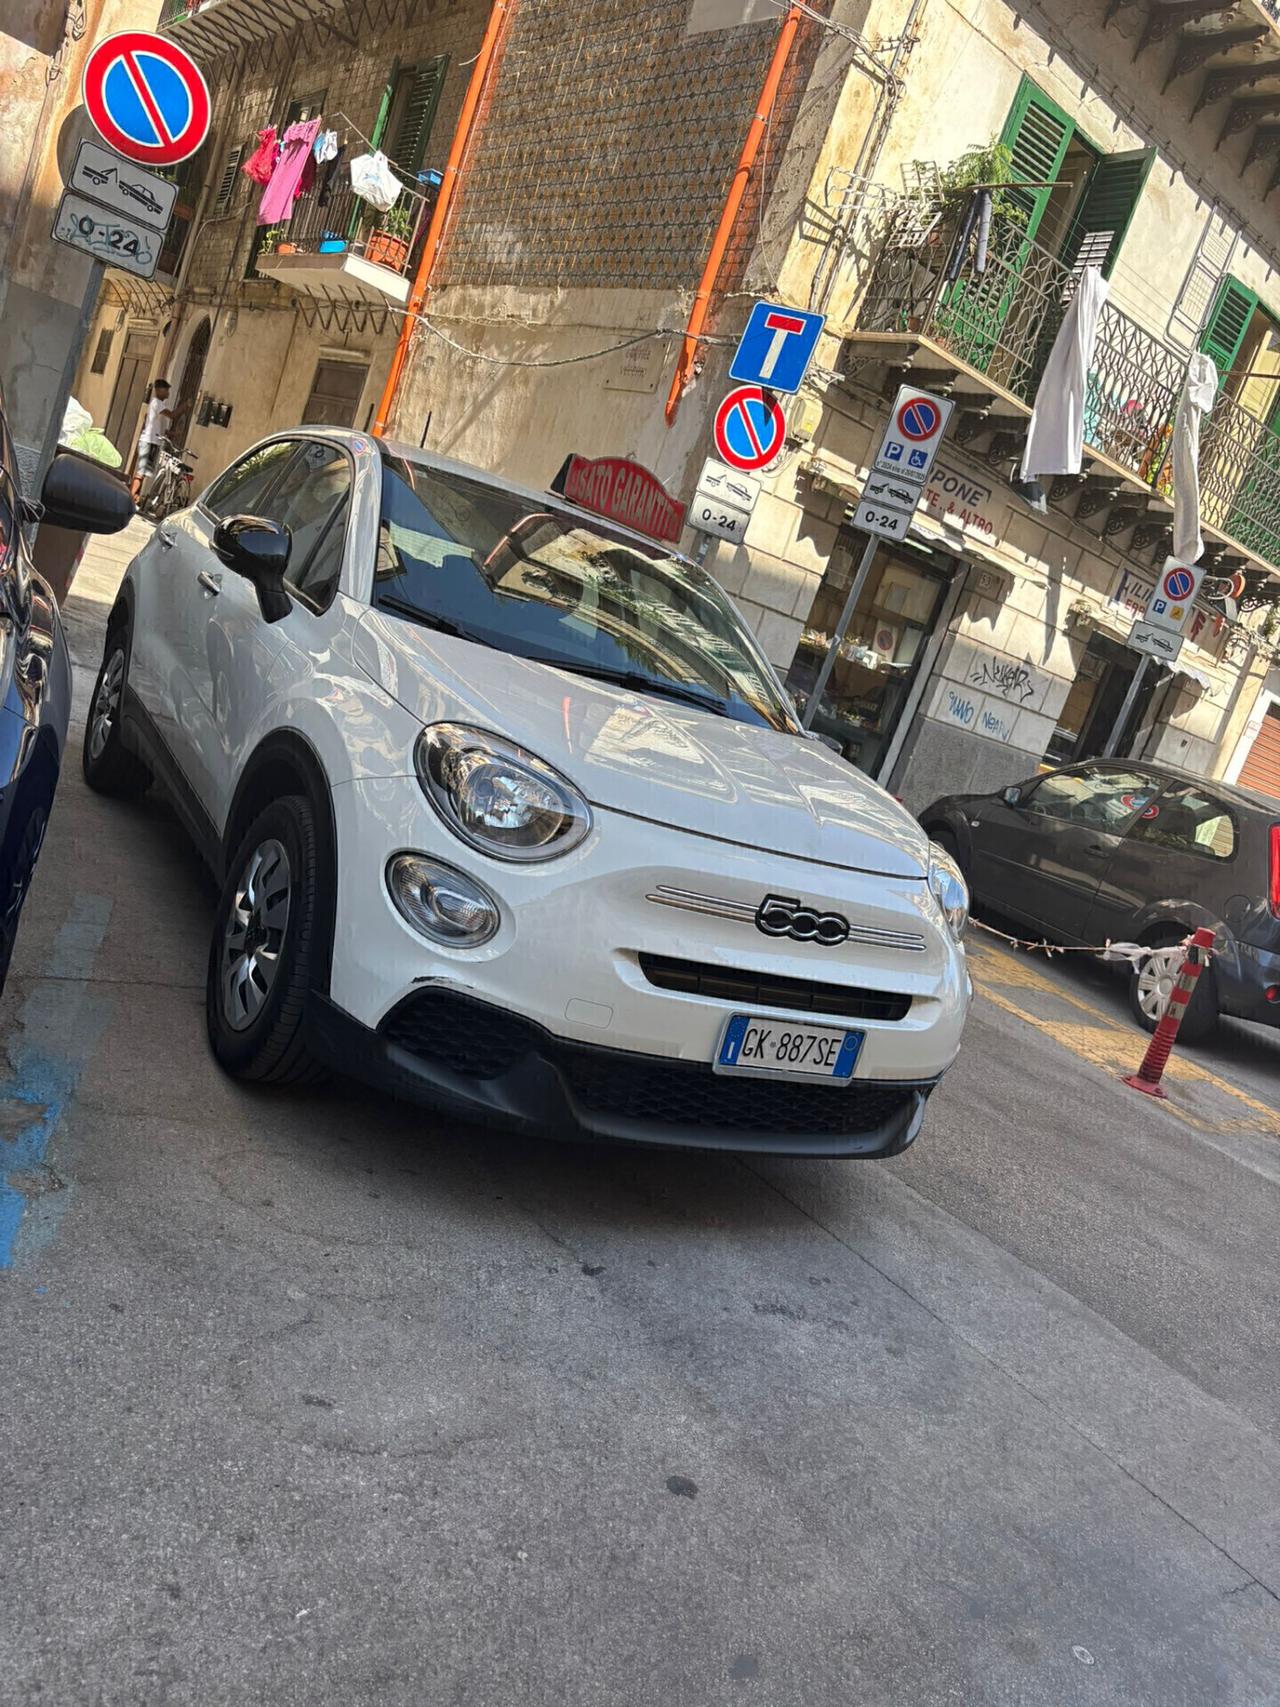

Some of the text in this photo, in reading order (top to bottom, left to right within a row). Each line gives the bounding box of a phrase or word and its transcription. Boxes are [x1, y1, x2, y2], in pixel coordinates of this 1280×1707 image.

[887, 443, 901, 458] P
[930, 466, 984, 507] PONE
[567, 464, 681, 540] USATO GARANTITO
[702, 508, 737, 531] 0-24
[865, 511, 898, 531] 0-24
[959, 509, 994, 536] ALTRO
[1155, 601, 1165, 613] P
[756, 894, 849, 945] 500
[727, 1041, 735, 1060] I
[775, 1032, 843, 1067] 887SE
